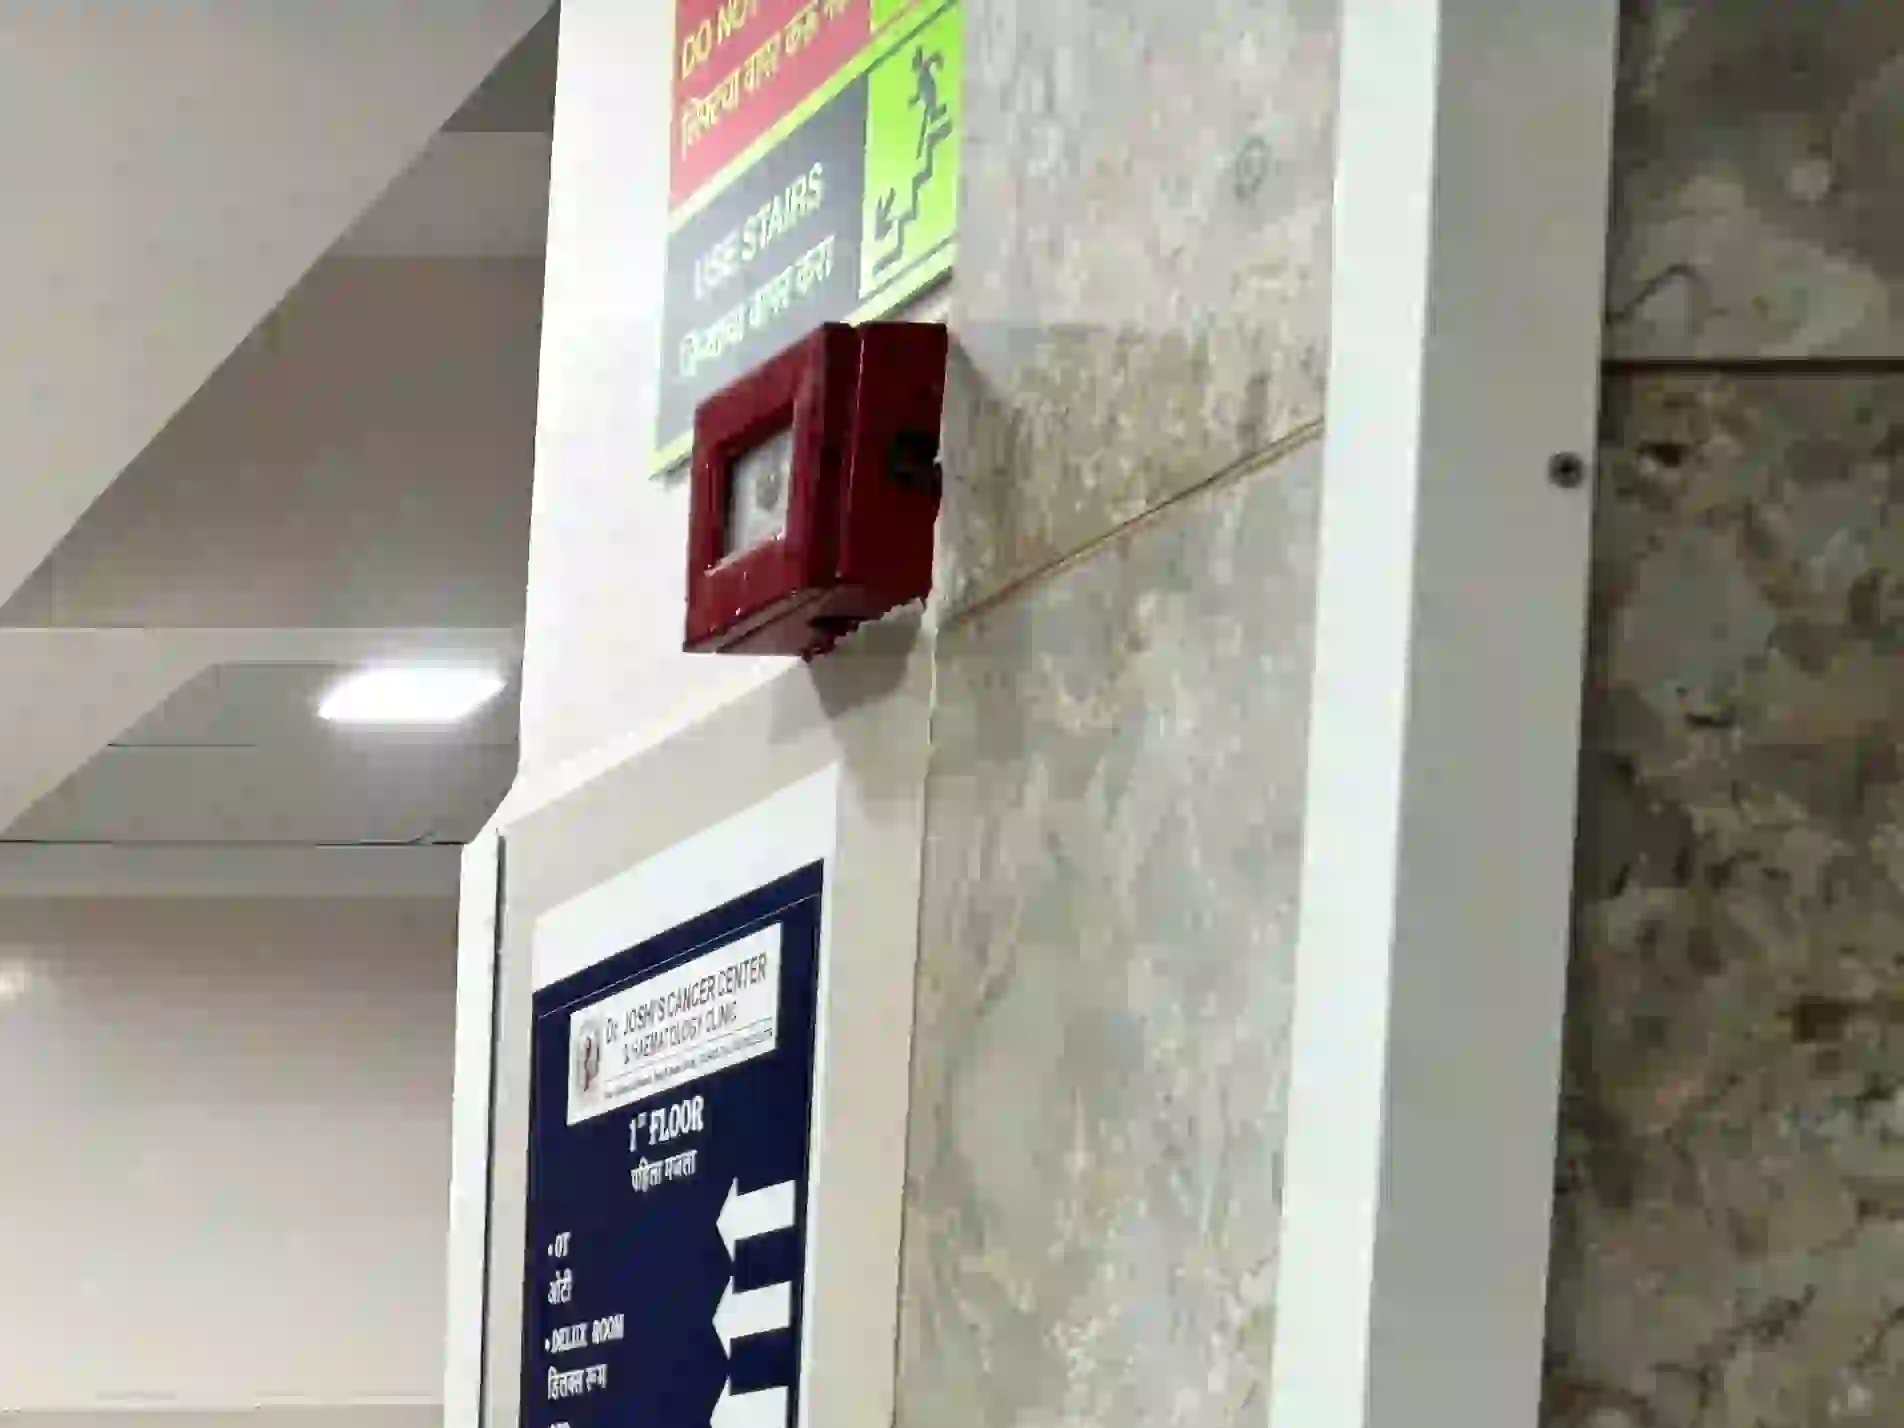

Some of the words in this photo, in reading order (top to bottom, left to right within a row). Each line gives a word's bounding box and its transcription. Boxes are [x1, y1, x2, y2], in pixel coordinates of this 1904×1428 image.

[682, 19, 712, 80] DO
[741, 161, 824, 262] STAIRS
[666, 975, 715, 1016] CANCER
[717, 952, 767, 997] CENTER
[648, 1095, 705, 1146] FLOOR
[554, 1231, 571, 1258] OT
[592, 1313, 625, 1344] ROOM
